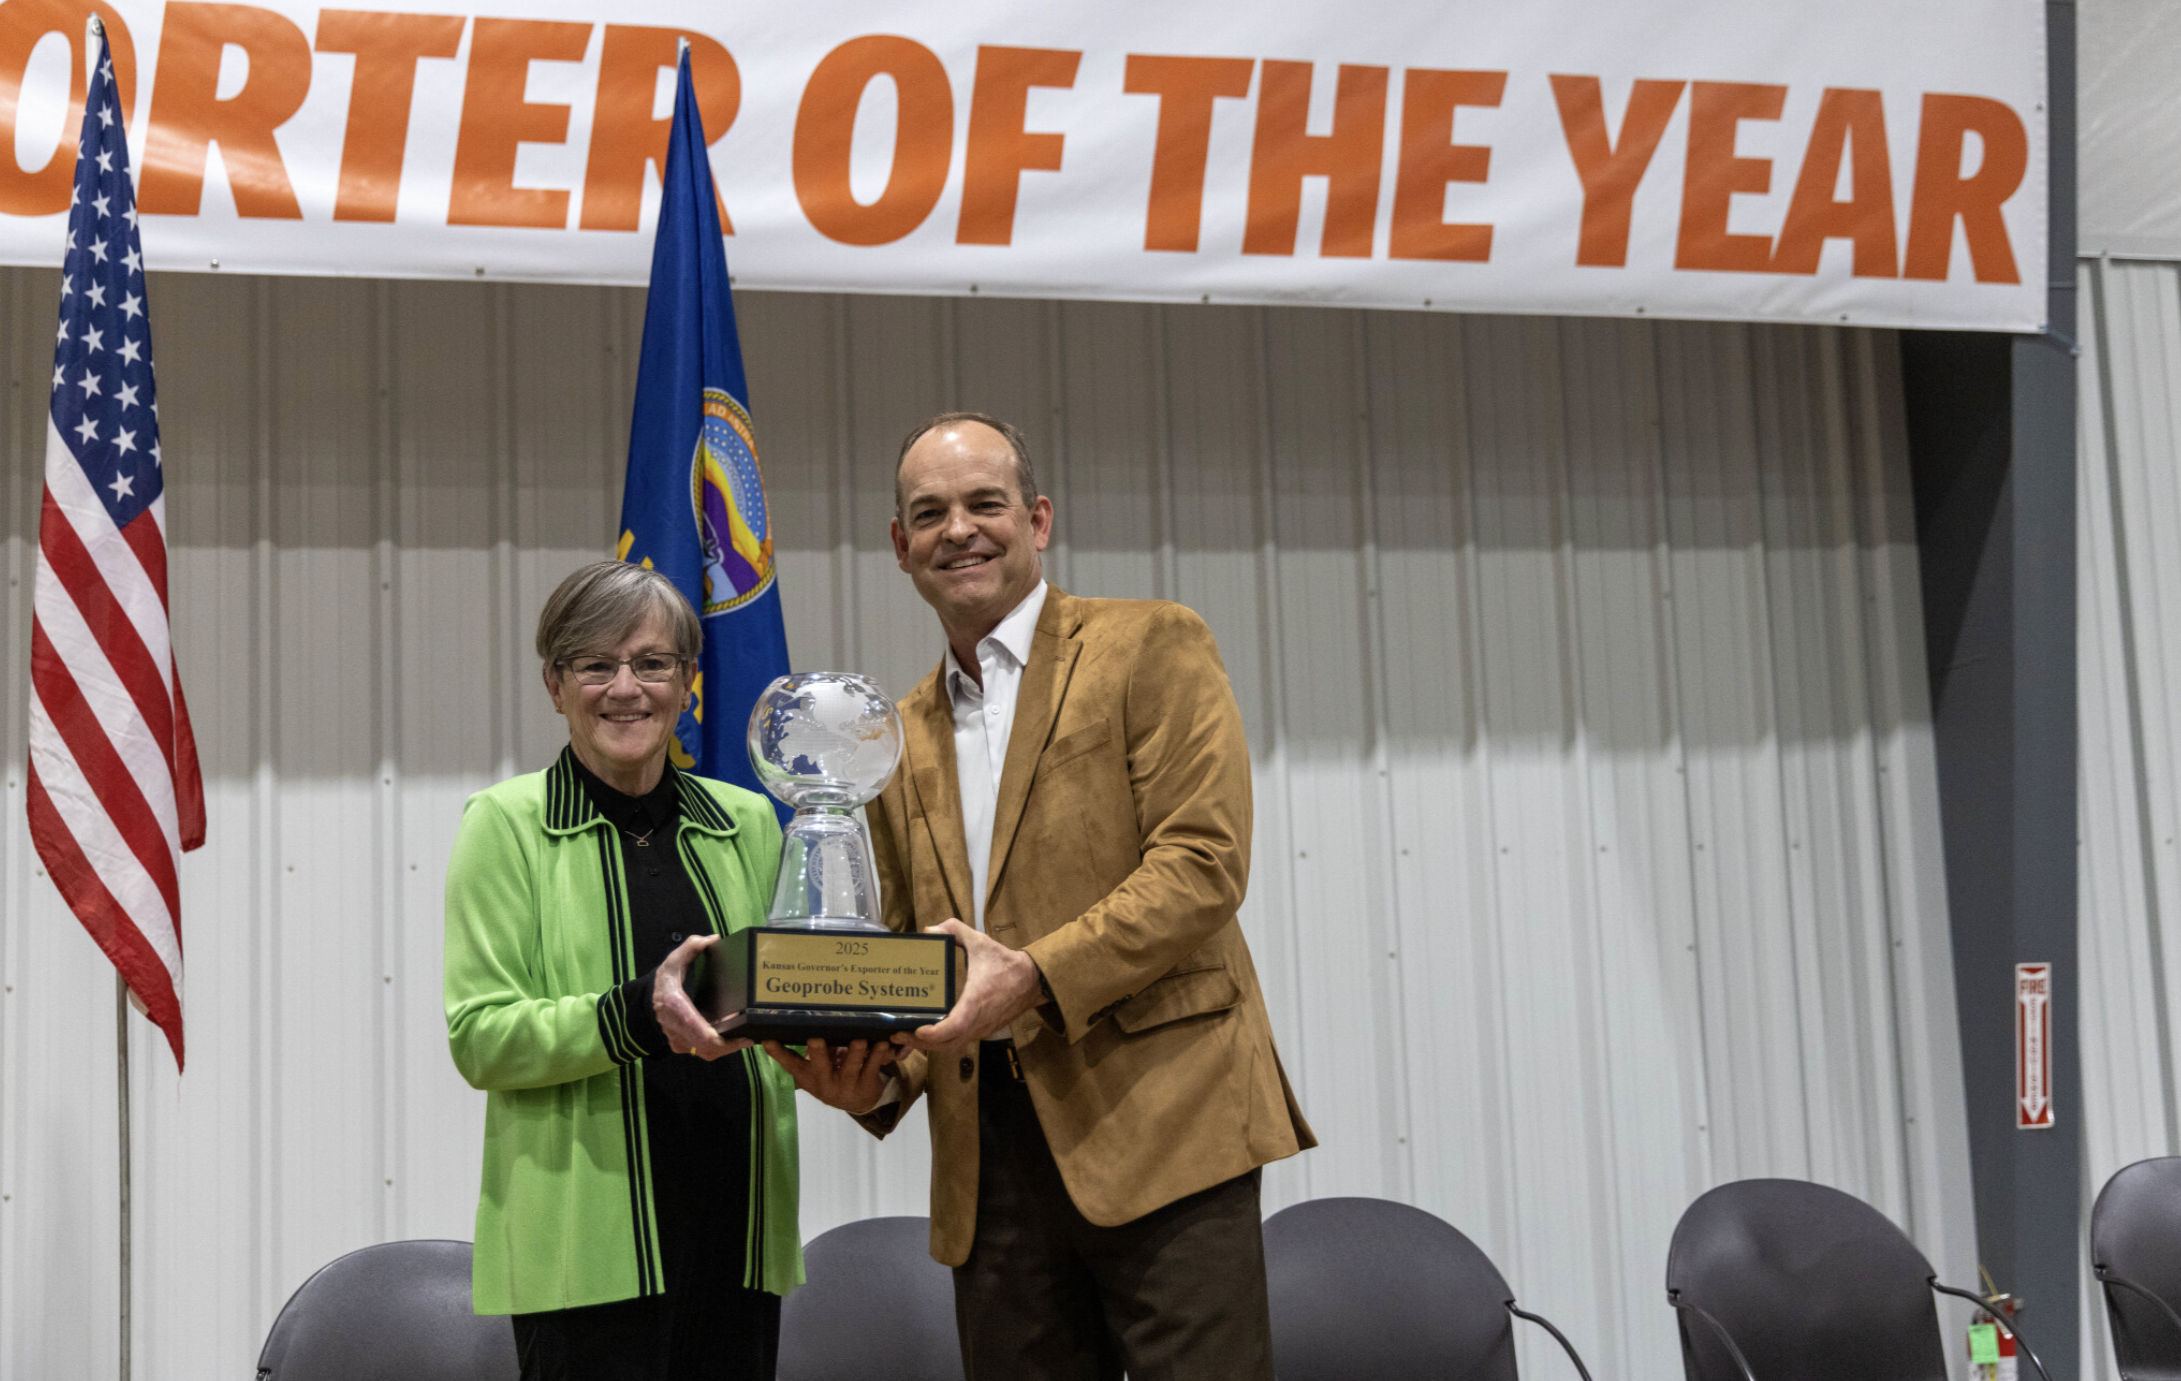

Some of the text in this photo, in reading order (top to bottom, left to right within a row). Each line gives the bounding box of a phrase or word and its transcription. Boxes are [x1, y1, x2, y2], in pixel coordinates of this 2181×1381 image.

[0, 0, 2029, 284] ORTER OF THE YEAR
[708, 403, 754, 449] AD ASTRA
[835, 941, 869, 956] 2025
[763, 961, 940, 976] Kansas Governor's Exporter of the Year
[766, 976, 853, 998] Geoprobe
[2020, 979, 2046, 994] FIRE
